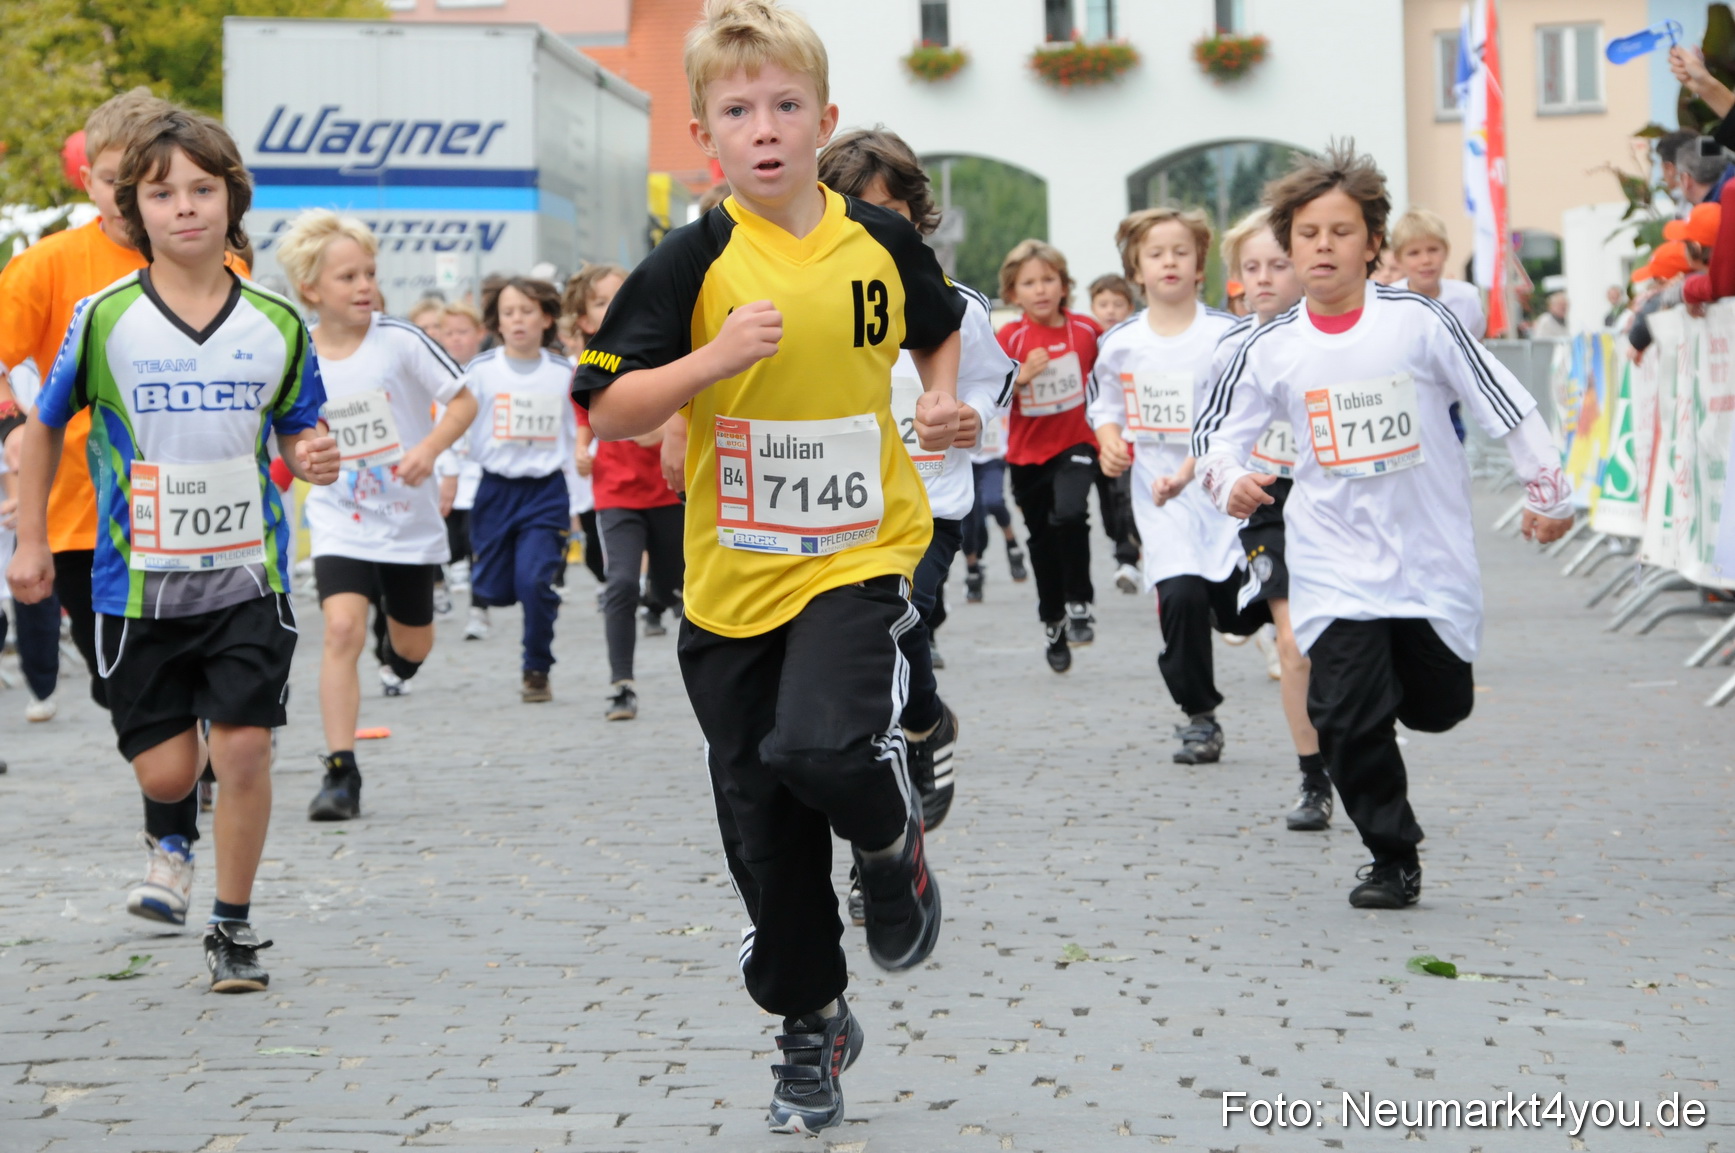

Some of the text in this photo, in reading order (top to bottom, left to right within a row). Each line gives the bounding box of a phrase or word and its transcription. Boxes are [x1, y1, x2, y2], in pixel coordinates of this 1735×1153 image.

[255, 105, 506, 172] Wagner
[851, 279, 889, 348] 13
[133, 359, 196, 373] TEAM
[1037, 374, 1077, 398] 7136
[133, 381, 267, 413] BOCK
[1335, 392, 1383, 411] Tobias
[515, 414, 555, 432] 7117
[1142, 404, 1186, 423] 7215
[330, 419, 387, 447] 7075
[1314, 425, 1328, 438] B4
[1341, 411, 1412, 447] 7120
[760, 433, 824, 460] Julian
[914, 461, 944, 471] EIDERER
[166, 474, 207, 495] Luca
[723, 467, 744, 487] B4
[763, 471, 868, 512] 7146
[135, 504, 152, 519] B4
[169, 500, 251, 537] 7027
[733, 533, 777, 546] BOCK
[820, 527, 876, 547] PFLEIDERER
[214, 546, 262, 562] PFLEIDERER
